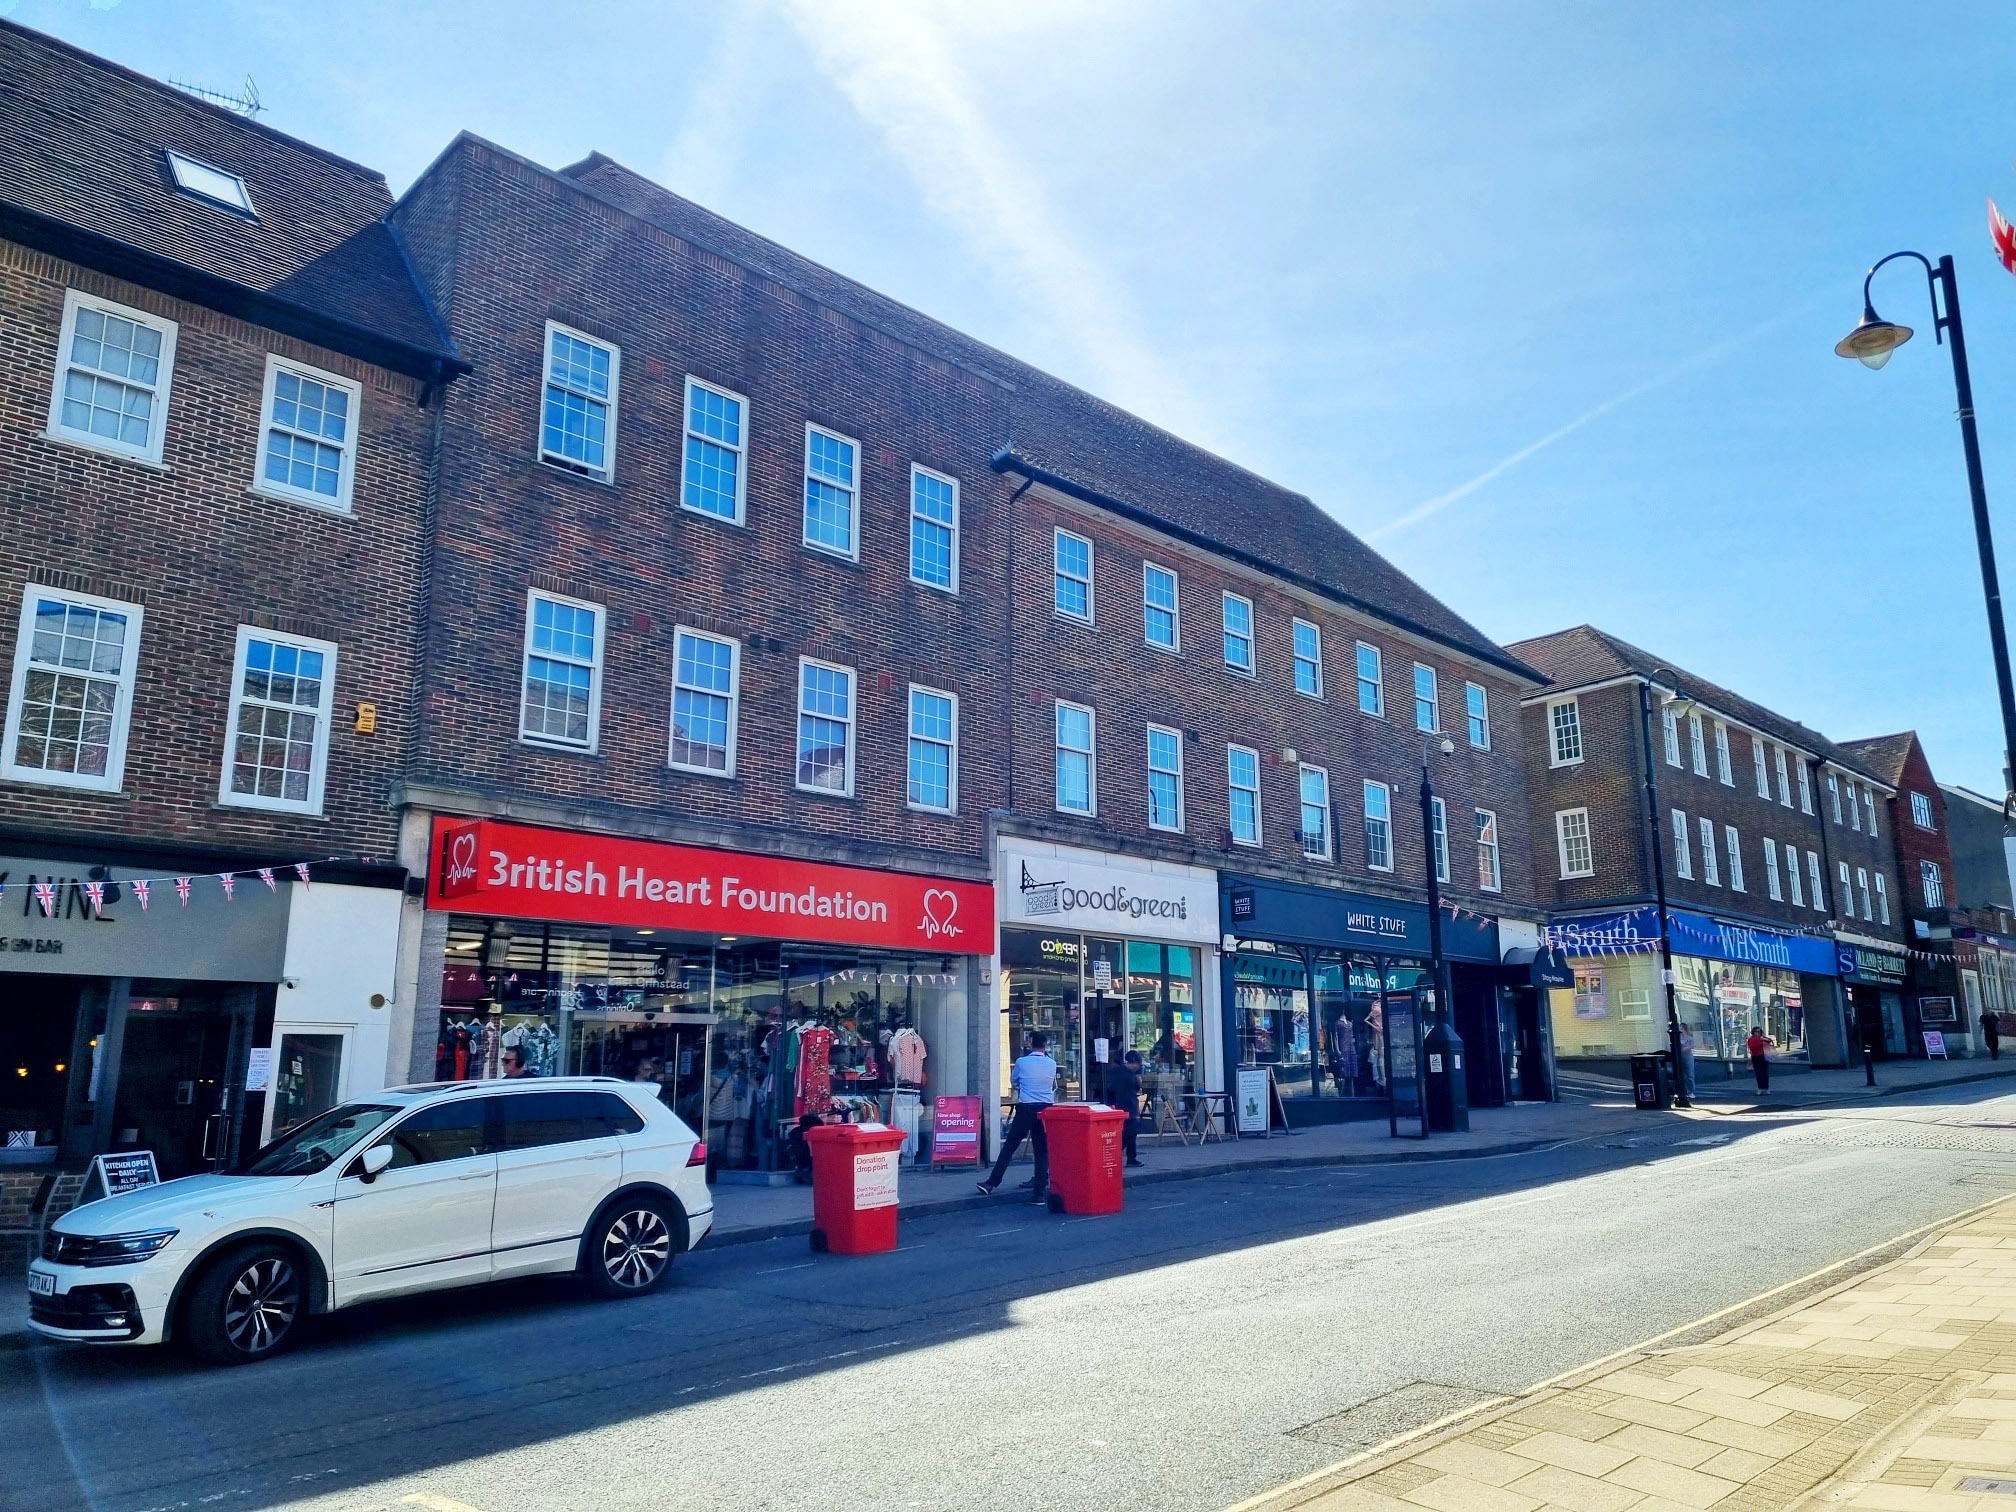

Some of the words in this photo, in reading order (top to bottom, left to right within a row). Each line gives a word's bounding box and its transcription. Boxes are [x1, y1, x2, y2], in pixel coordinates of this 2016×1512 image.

[618, 865, 712, 906] Heart
[721, 876, 887, 923] Foundation
[1234, 897, 1251, 905] WHITE
[1347, 911, 1376, 929] WHITE
[1379, 916, 1406, 933] STUFF
[35, 939, 63, 954] BAR
[1718, 925, 1791, 966] WHSmith
[1839, 953, 1854, 973] S
[941, 1118, 974, 1127] opening
[856, 1156, 886, 1165] Donation
[856, 1165, 872, 1173] drop
[872, 1163, 889, 1173] point
